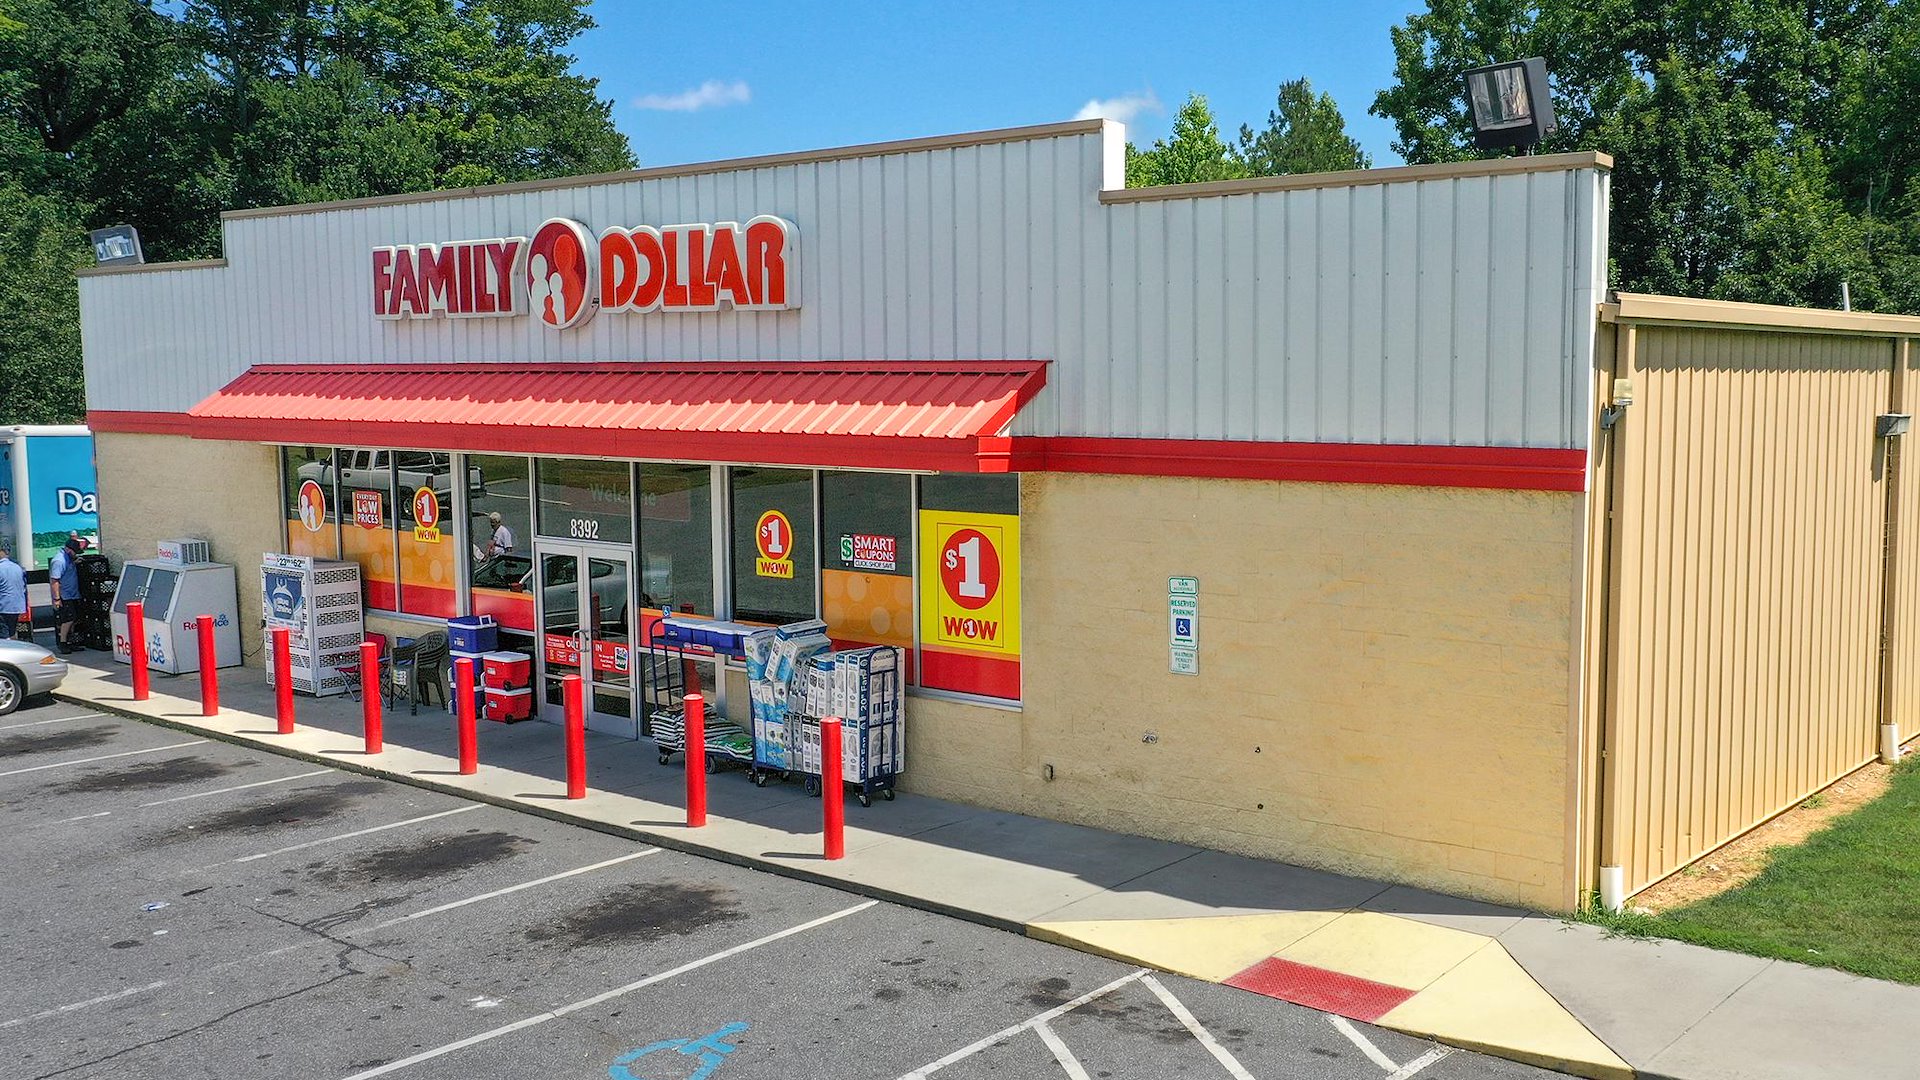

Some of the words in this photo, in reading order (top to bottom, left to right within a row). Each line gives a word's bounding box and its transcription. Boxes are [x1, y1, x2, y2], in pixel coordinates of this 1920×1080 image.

[373, 241, 519, 315] FAMILY
[600, 221, 785, 309] DOLLAR
[416, 493, 433, 523] $1
[357, 512, 379, 525] PRICES
[570, 518, 599, 540] 8392
[761, 519, 783, 554] $1
[854, 535, 894, 551] SMART
[854, 549, 894, 562] COUPONS
[945, 537, 986, 598] $1
[1170, 600, 1195, 608] RESERVED
[1172, 608, 1194, 616] PARKING
